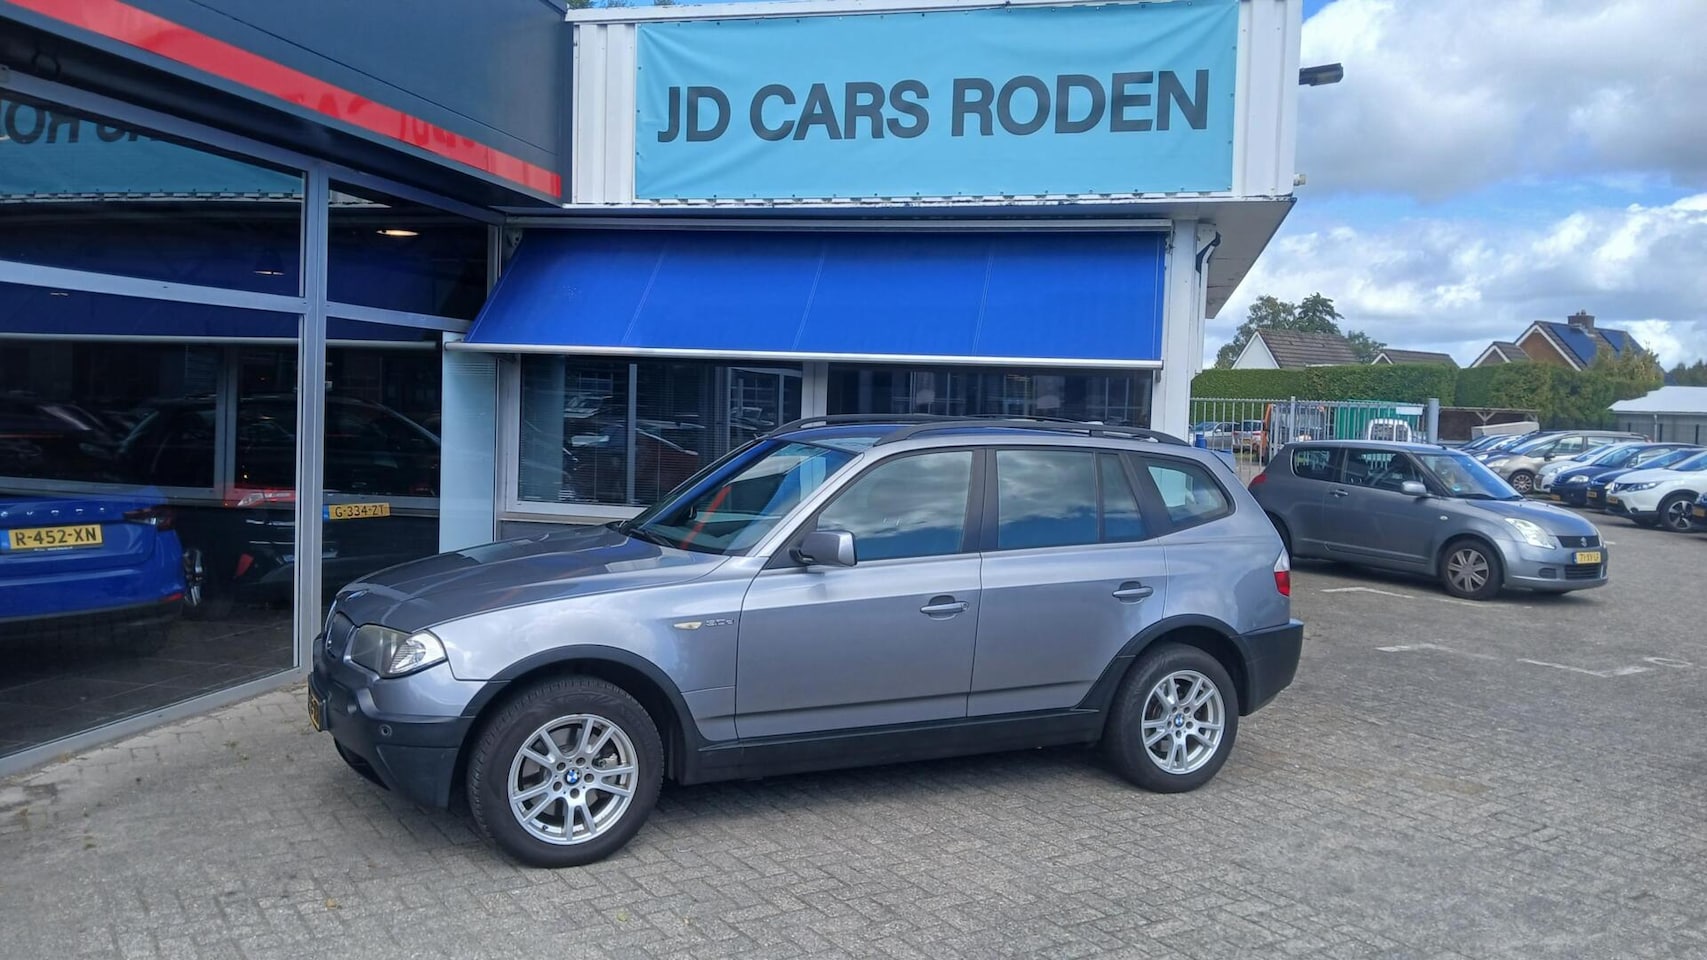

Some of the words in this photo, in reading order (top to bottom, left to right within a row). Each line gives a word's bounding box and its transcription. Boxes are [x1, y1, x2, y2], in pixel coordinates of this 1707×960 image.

[658, 86, 731, 143] JD
[749, 80, 929, 142] CARS
[951, 69, 1210, 138] RODEN
[14, 527, 97, 547] R-452-XN
